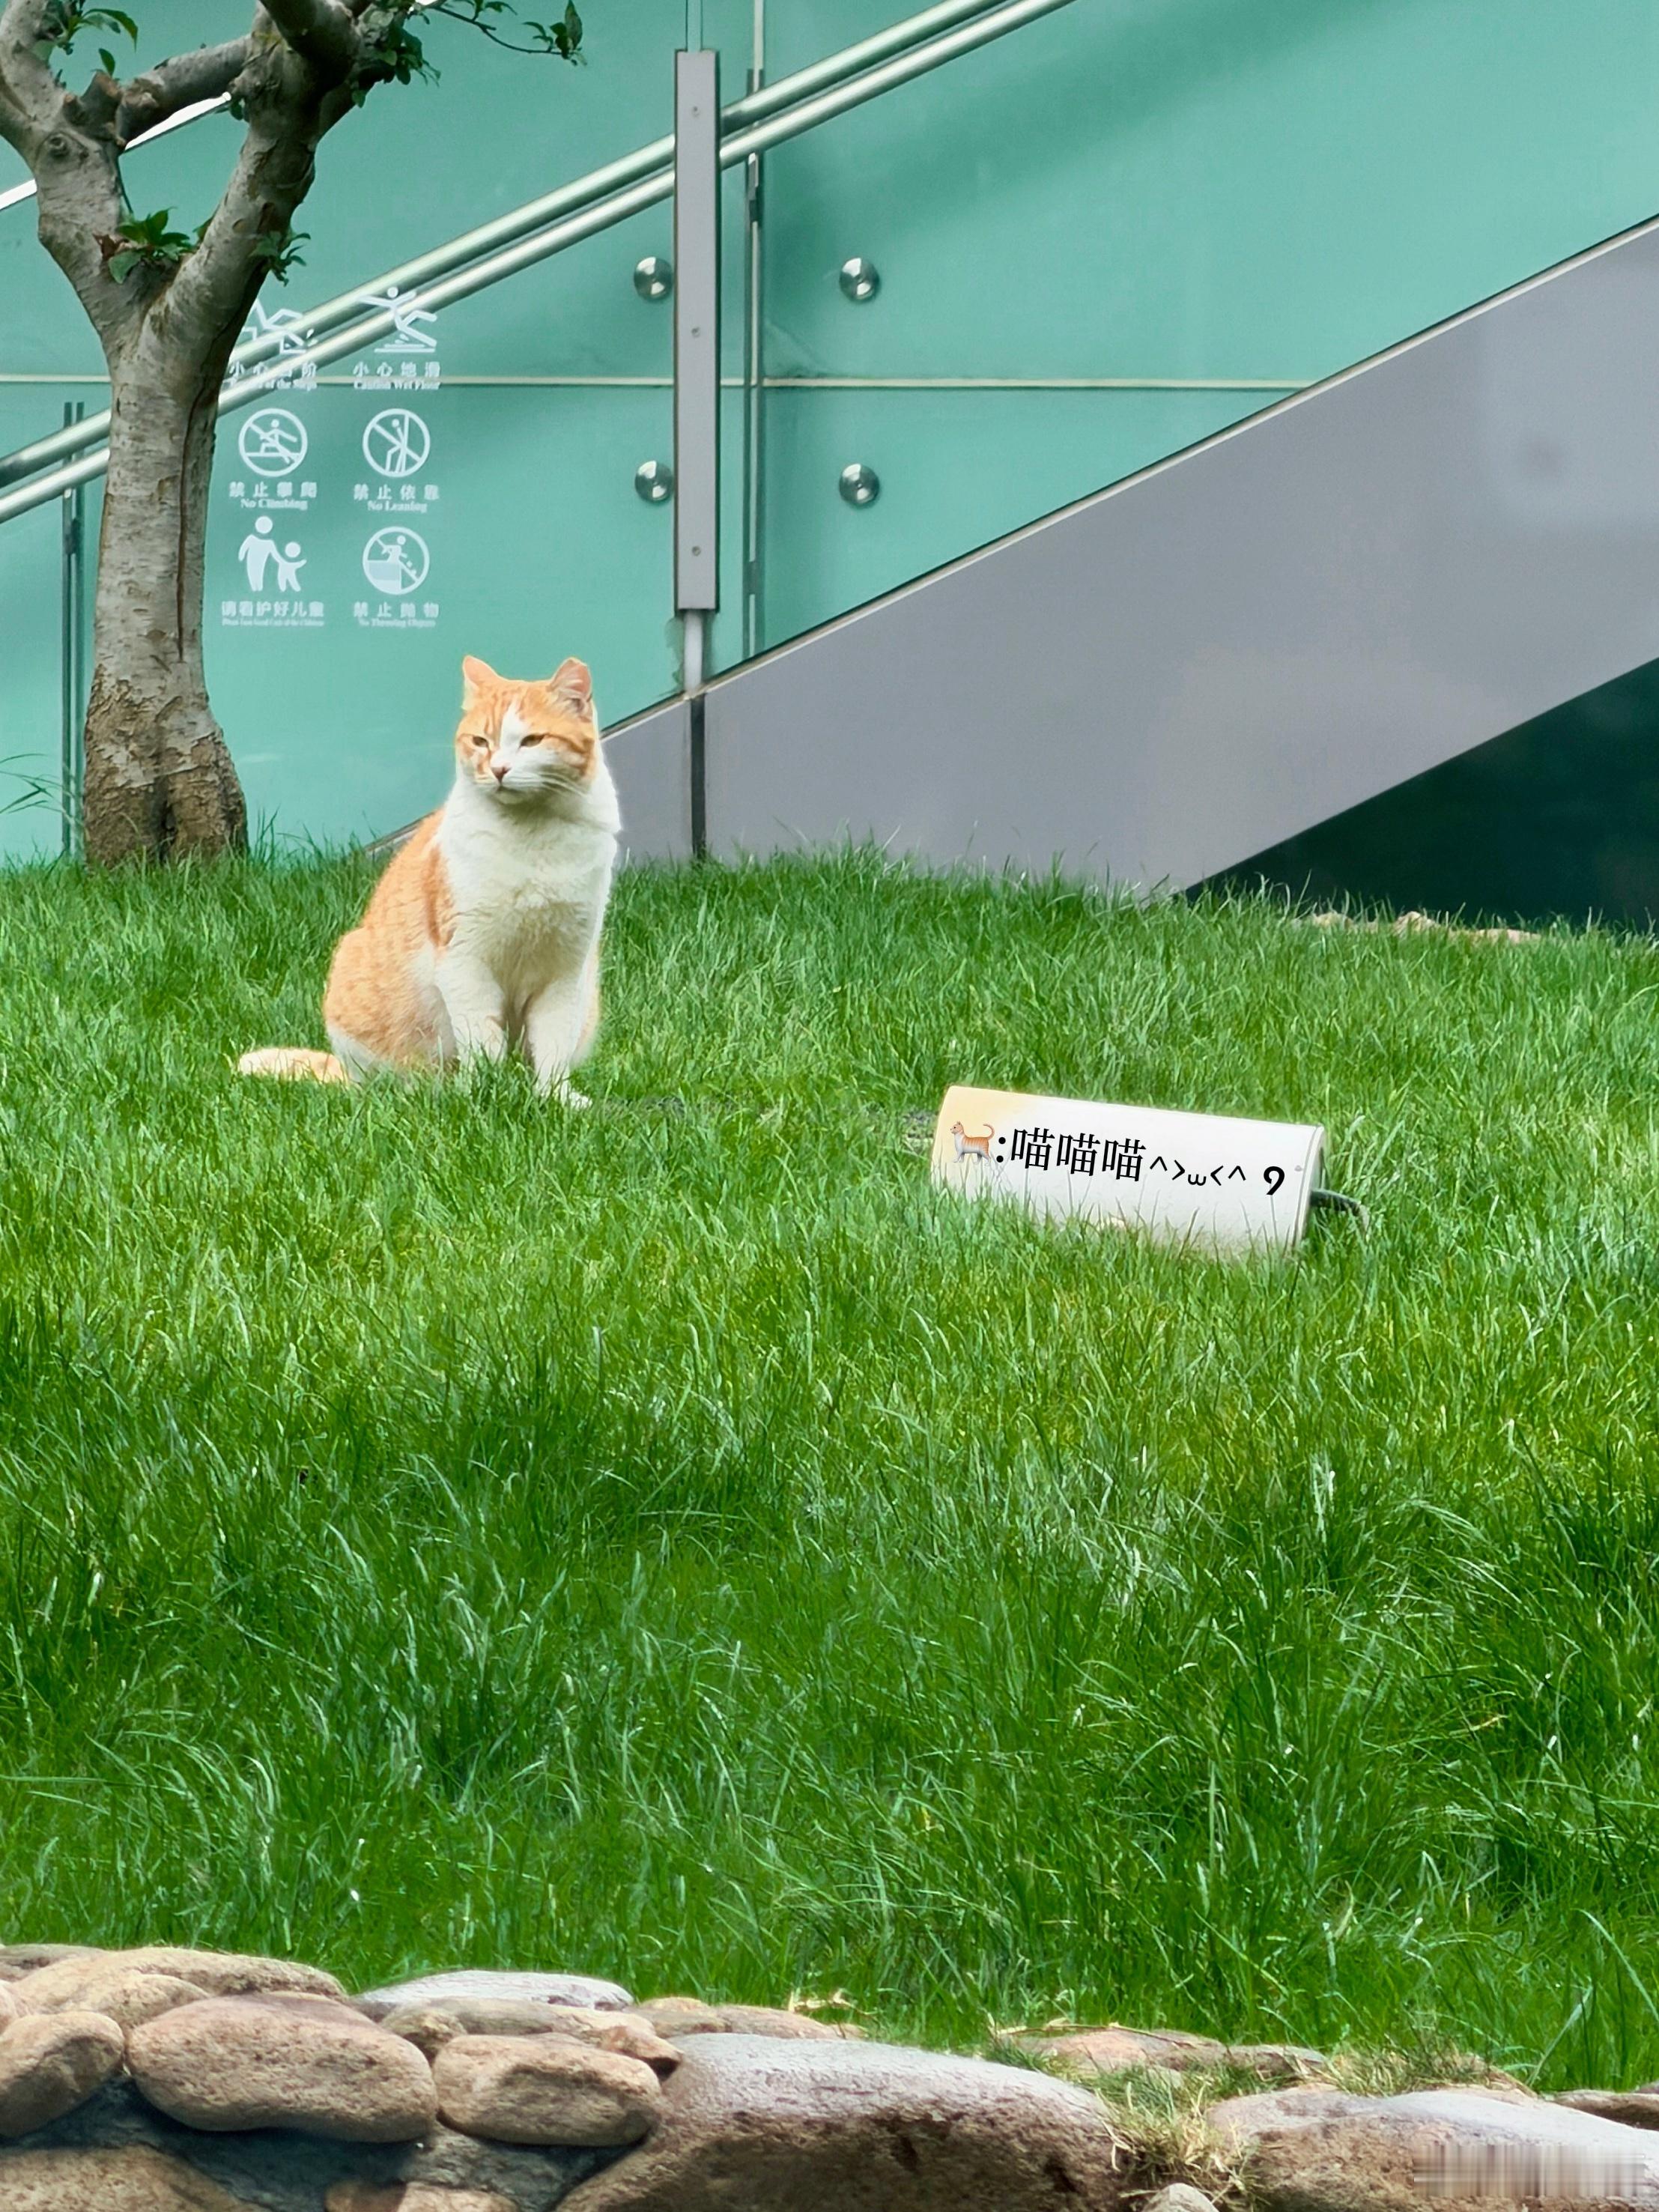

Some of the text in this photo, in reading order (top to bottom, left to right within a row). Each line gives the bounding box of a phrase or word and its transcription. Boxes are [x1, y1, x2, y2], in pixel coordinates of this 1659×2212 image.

[229, 360, 317, 378] 小心阶
[353, 361, 440, 378] 小心地滑
[240, 498, 308, 511] No Climbing
[367, 500, 428, 514] No Leaning
